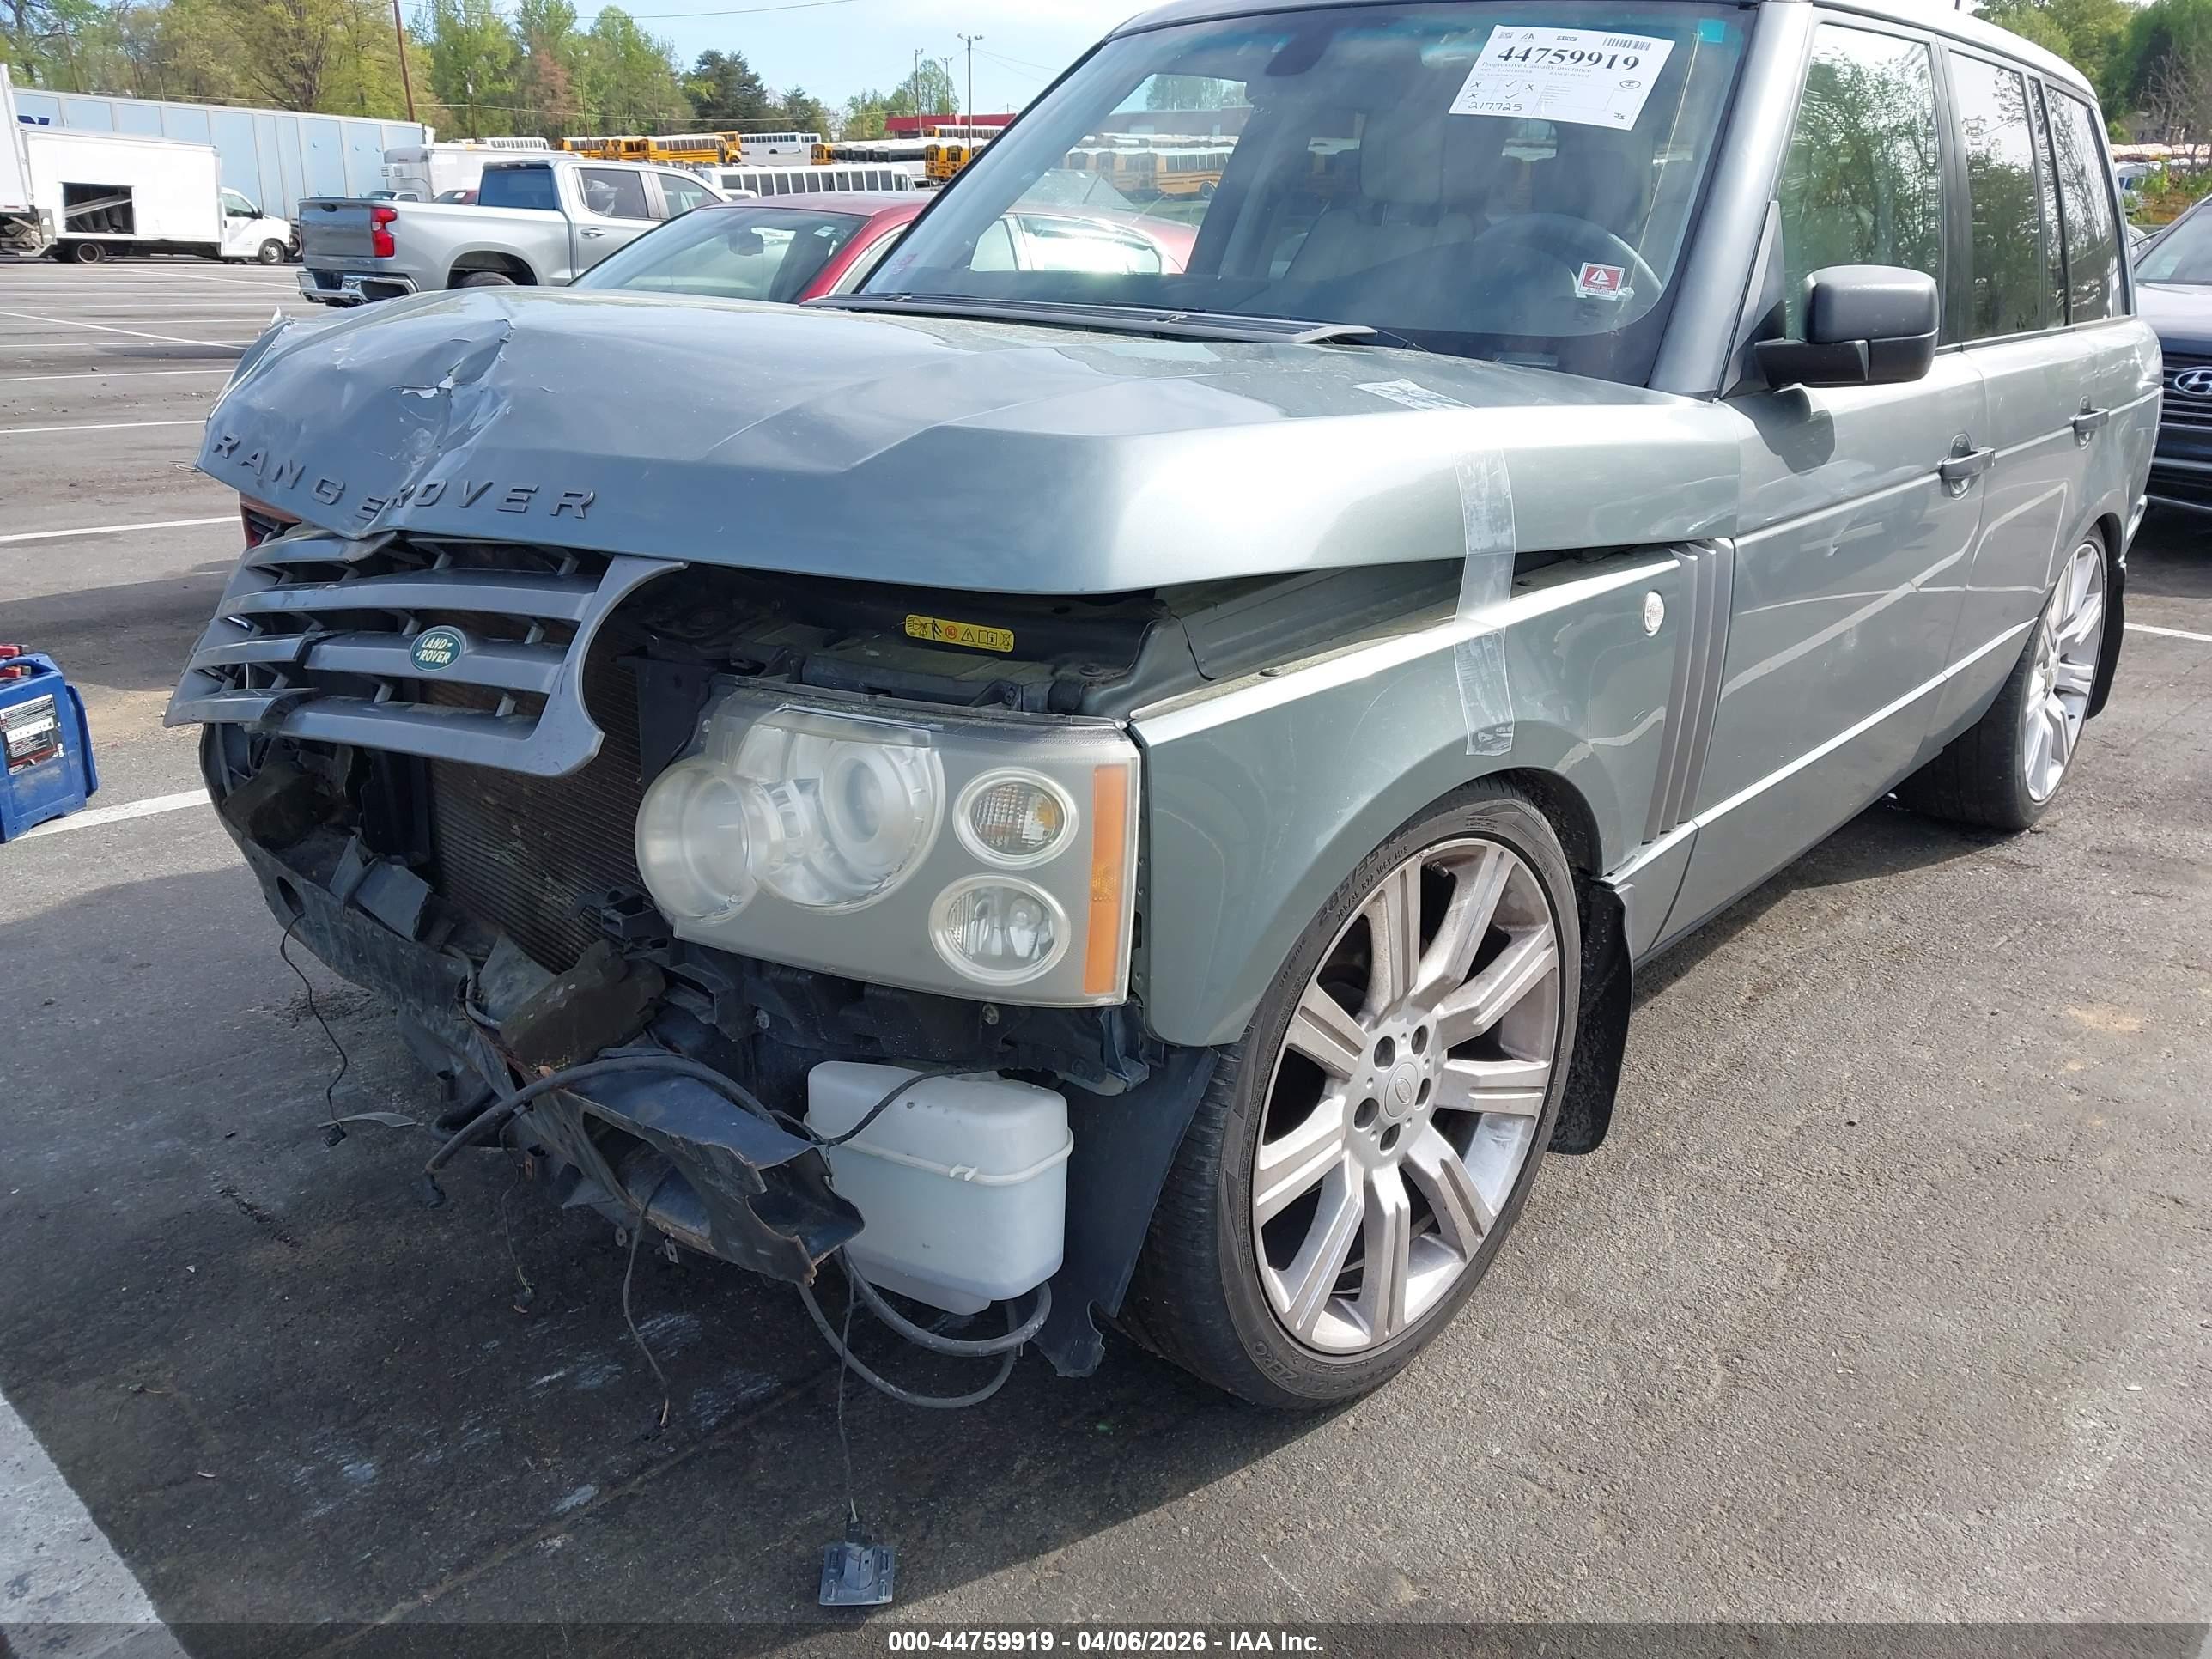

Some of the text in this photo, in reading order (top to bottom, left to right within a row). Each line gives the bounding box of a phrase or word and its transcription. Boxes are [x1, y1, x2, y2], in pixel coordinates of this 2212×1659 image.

[1497, 46, 1640, 72] 44759919
[212, 432, 596, 522] RANGE ROVER
[1254, 1340, 1300, 1381] ZERO
